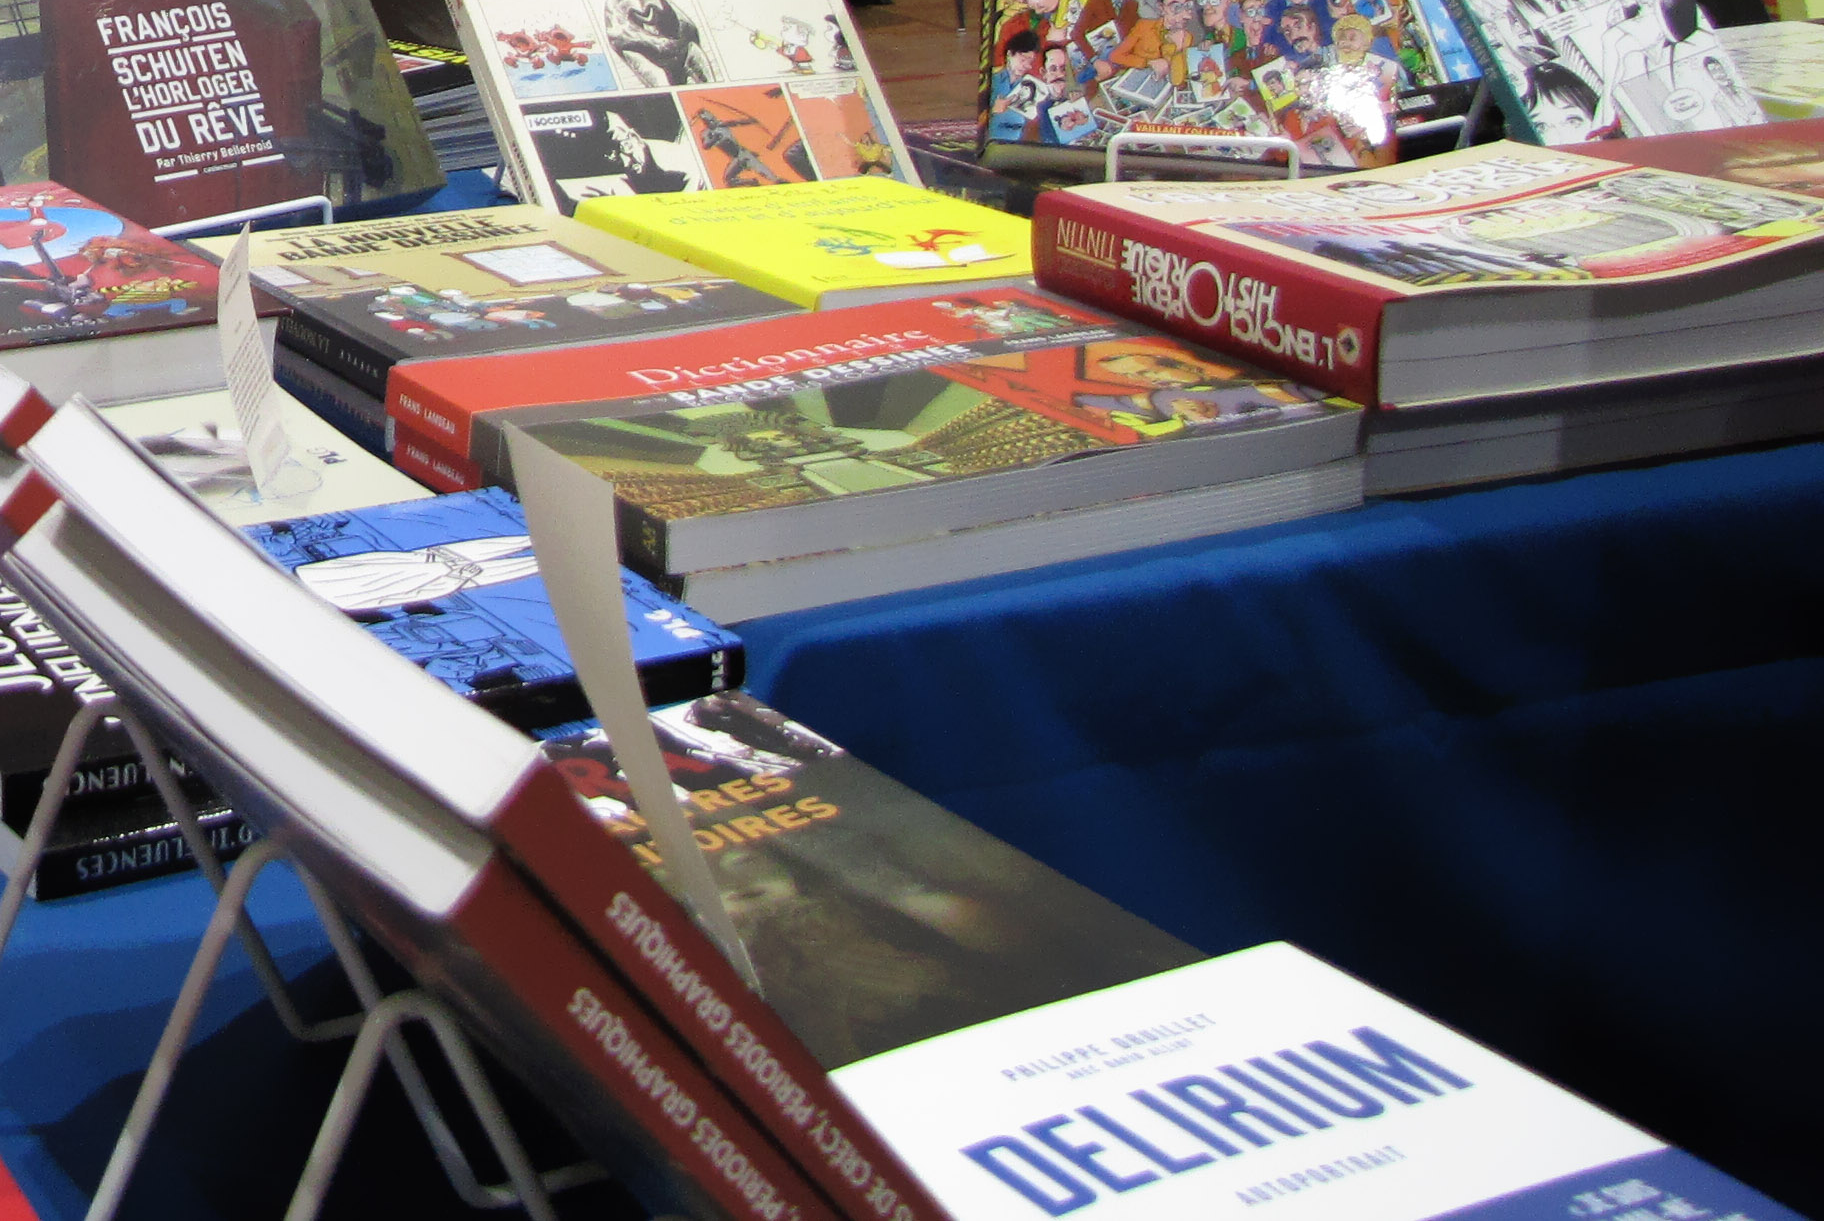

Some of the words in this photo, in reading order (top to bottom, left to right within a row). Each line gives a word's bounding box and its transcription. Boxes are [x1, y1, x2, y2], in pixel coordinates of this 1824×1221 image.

[96, 1, 233, 46] FRANÇOIS
[111, 39, 248, 85] SCHUITEN
[122, 69, 259, 111] L'HORLOGER
[135, 116, 182, 154] DU
[188, 100, 274, 145] RÊVE
[155, 157, 176, 169] Par
[178, 146, 219, 166] Thierry
[220, 139, 274, 157] Bellefroid
[277, 243, 391, 262] BANDE
[289, 235, 335, 249] LA
[338, 218, 503, 246] NOUVELLE
[1057, 216, 1117, 260] TINTIN
[626, 326, 932, 386] Dictionnaire
[672, 371, 788, 405] BANDE
[801, 342, 974, 381] DESSINÉE
[399, 392, 422, 415] FRANS
[407, 444, 430, 466] FRANS
[600, 889, 736, 1034] GRAPHIQUES
[563, 984, 701, 1130] GRAPHIQUES
[718, 1021, 820, 1127] PÉRIODES
[1001, 1042, 1107, 1082] PHILIPPE
[1109, 1013, 1217, 1050] DRUILLET
[958, 1025, 1476, 1219] DELIRIUM
[684, 1115, 789, 1221] PÉRIODES
[1235, 1144, 1408, 1207] AUTOPORTRAIT
